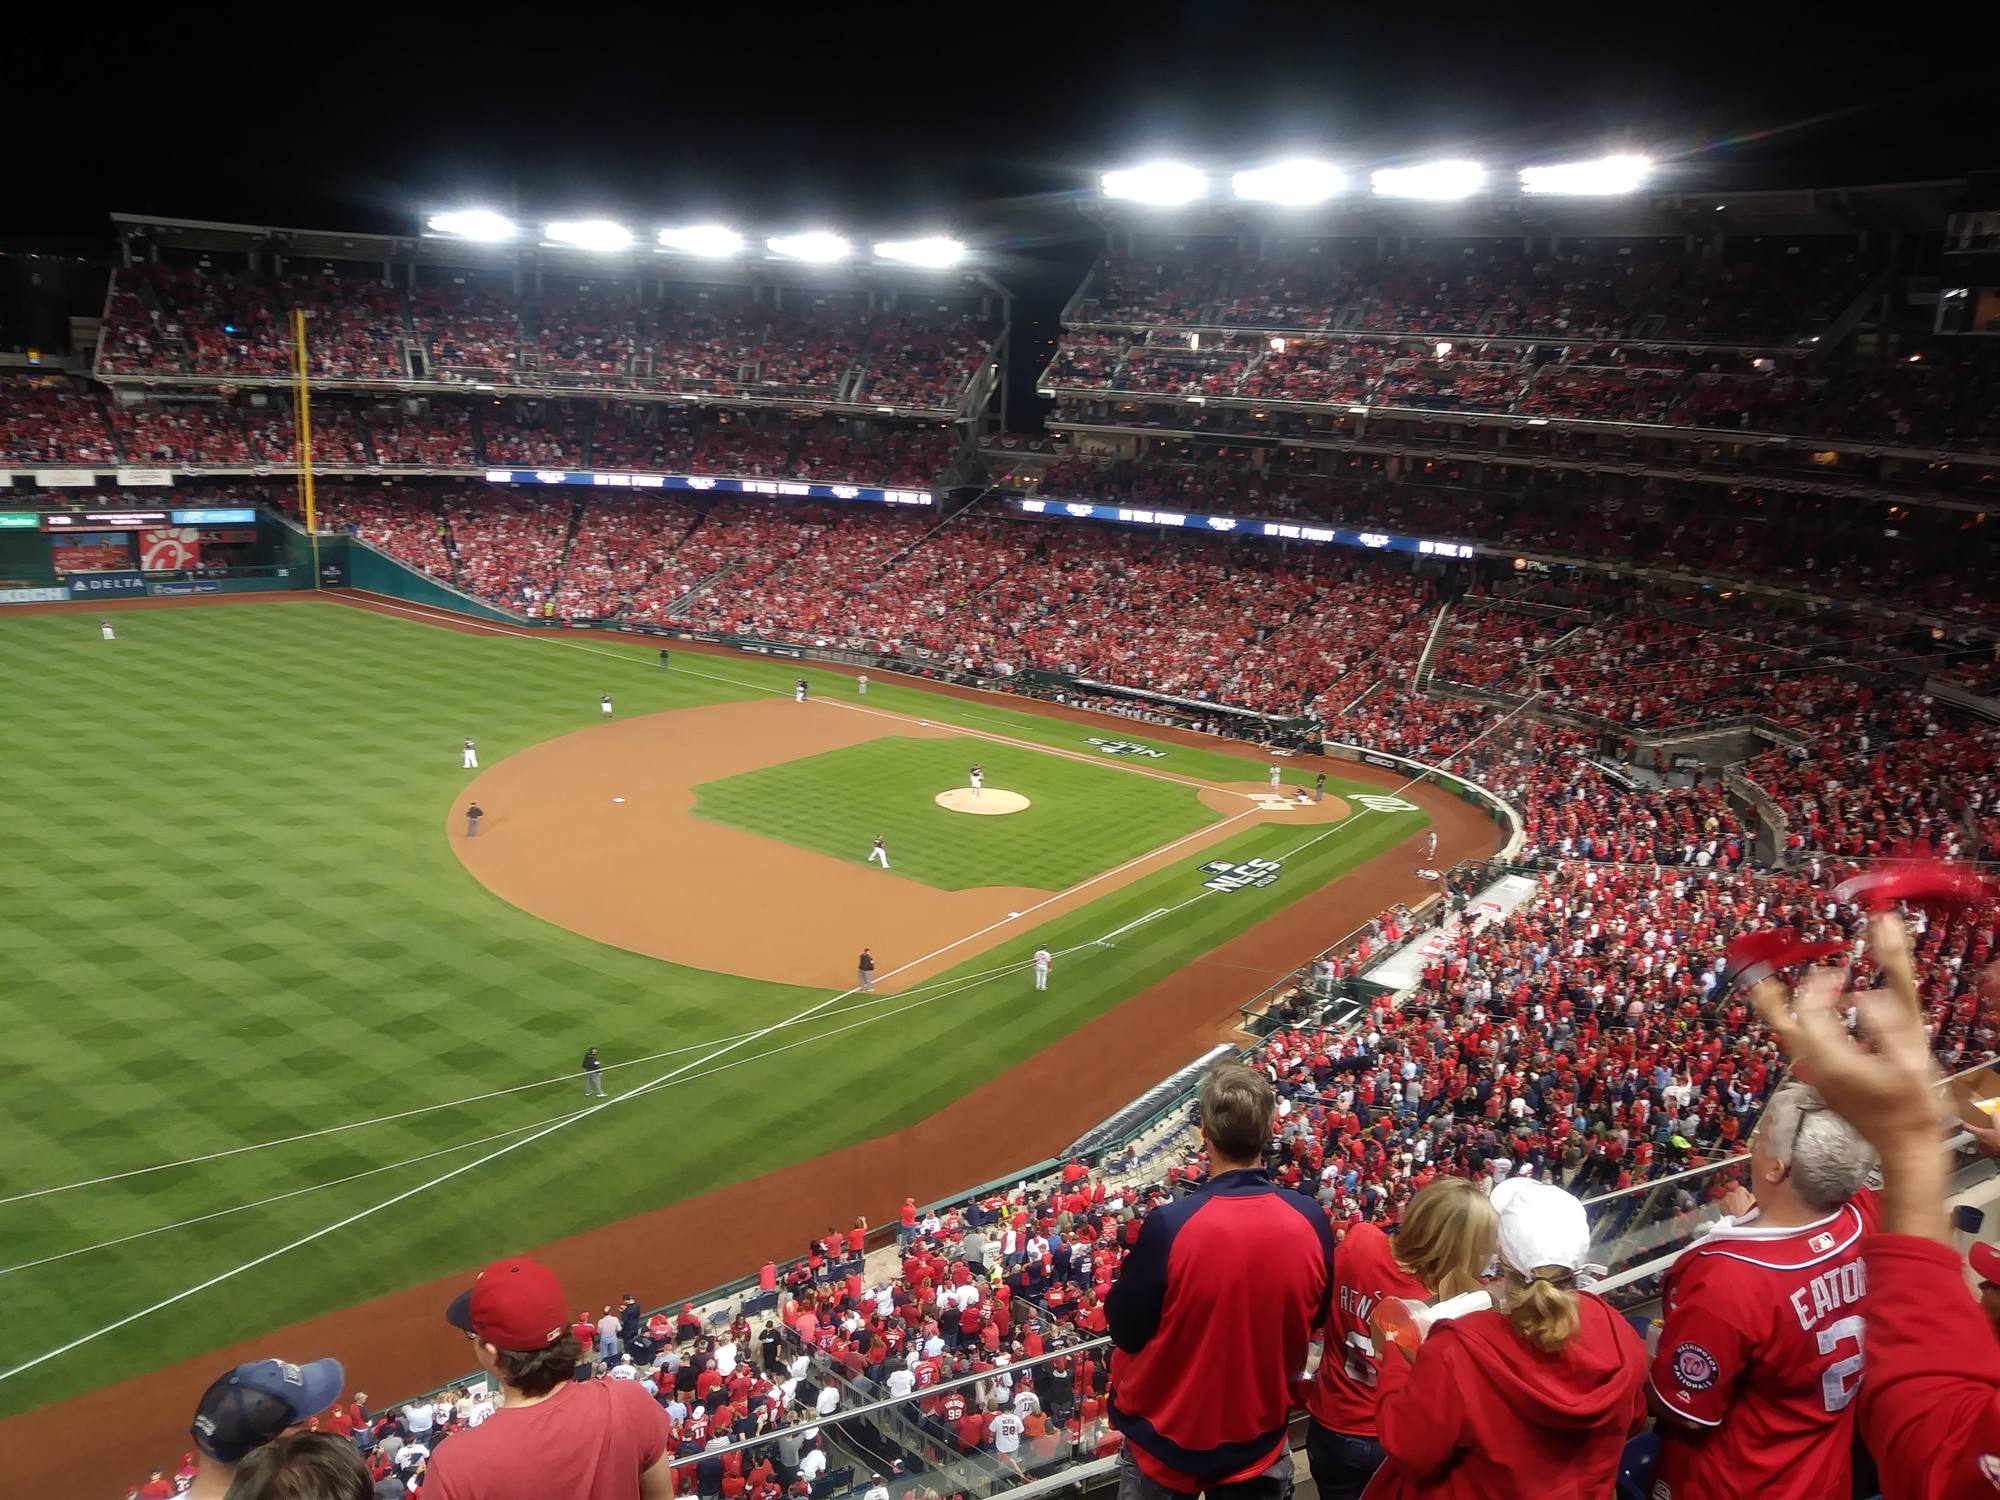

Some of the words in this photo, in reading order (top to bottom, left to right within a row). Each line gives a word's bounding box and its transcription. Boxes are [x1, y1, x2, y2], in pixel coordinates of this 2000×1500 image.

[90, 578, 145, 590] DELTA
[1365, 755, 1395, 768] GEICO
[1203, 858, 1281, 893] NLCS
[947, 1409, 962, 1420] 99
[694, 1428, 705, 1439] 11
[1002, 1426, 1016, 1436] 28
